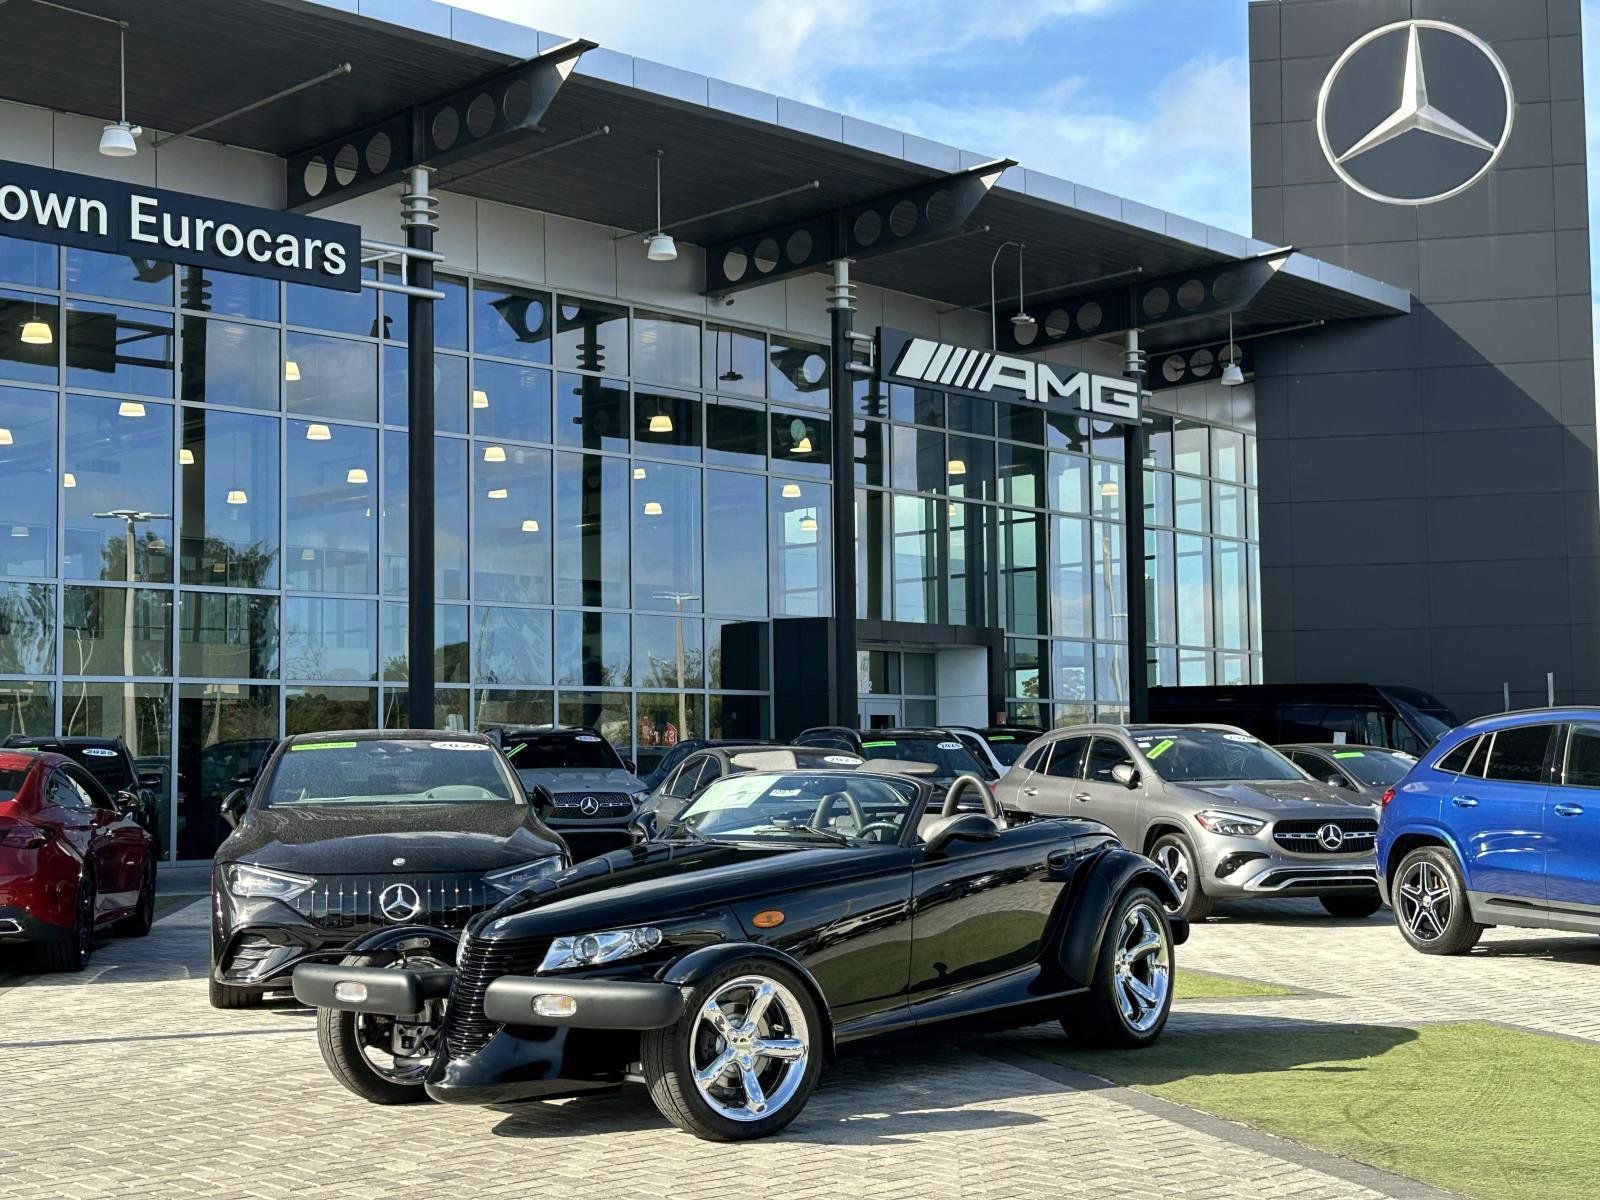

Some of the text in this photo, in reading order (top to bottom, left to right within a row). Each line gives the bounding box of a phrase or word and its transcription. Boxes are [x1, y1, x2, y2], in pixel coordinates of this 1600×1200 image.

[0, 184, 347, 275] own Eurocars
[979, 354, 1139, 419] AMG
